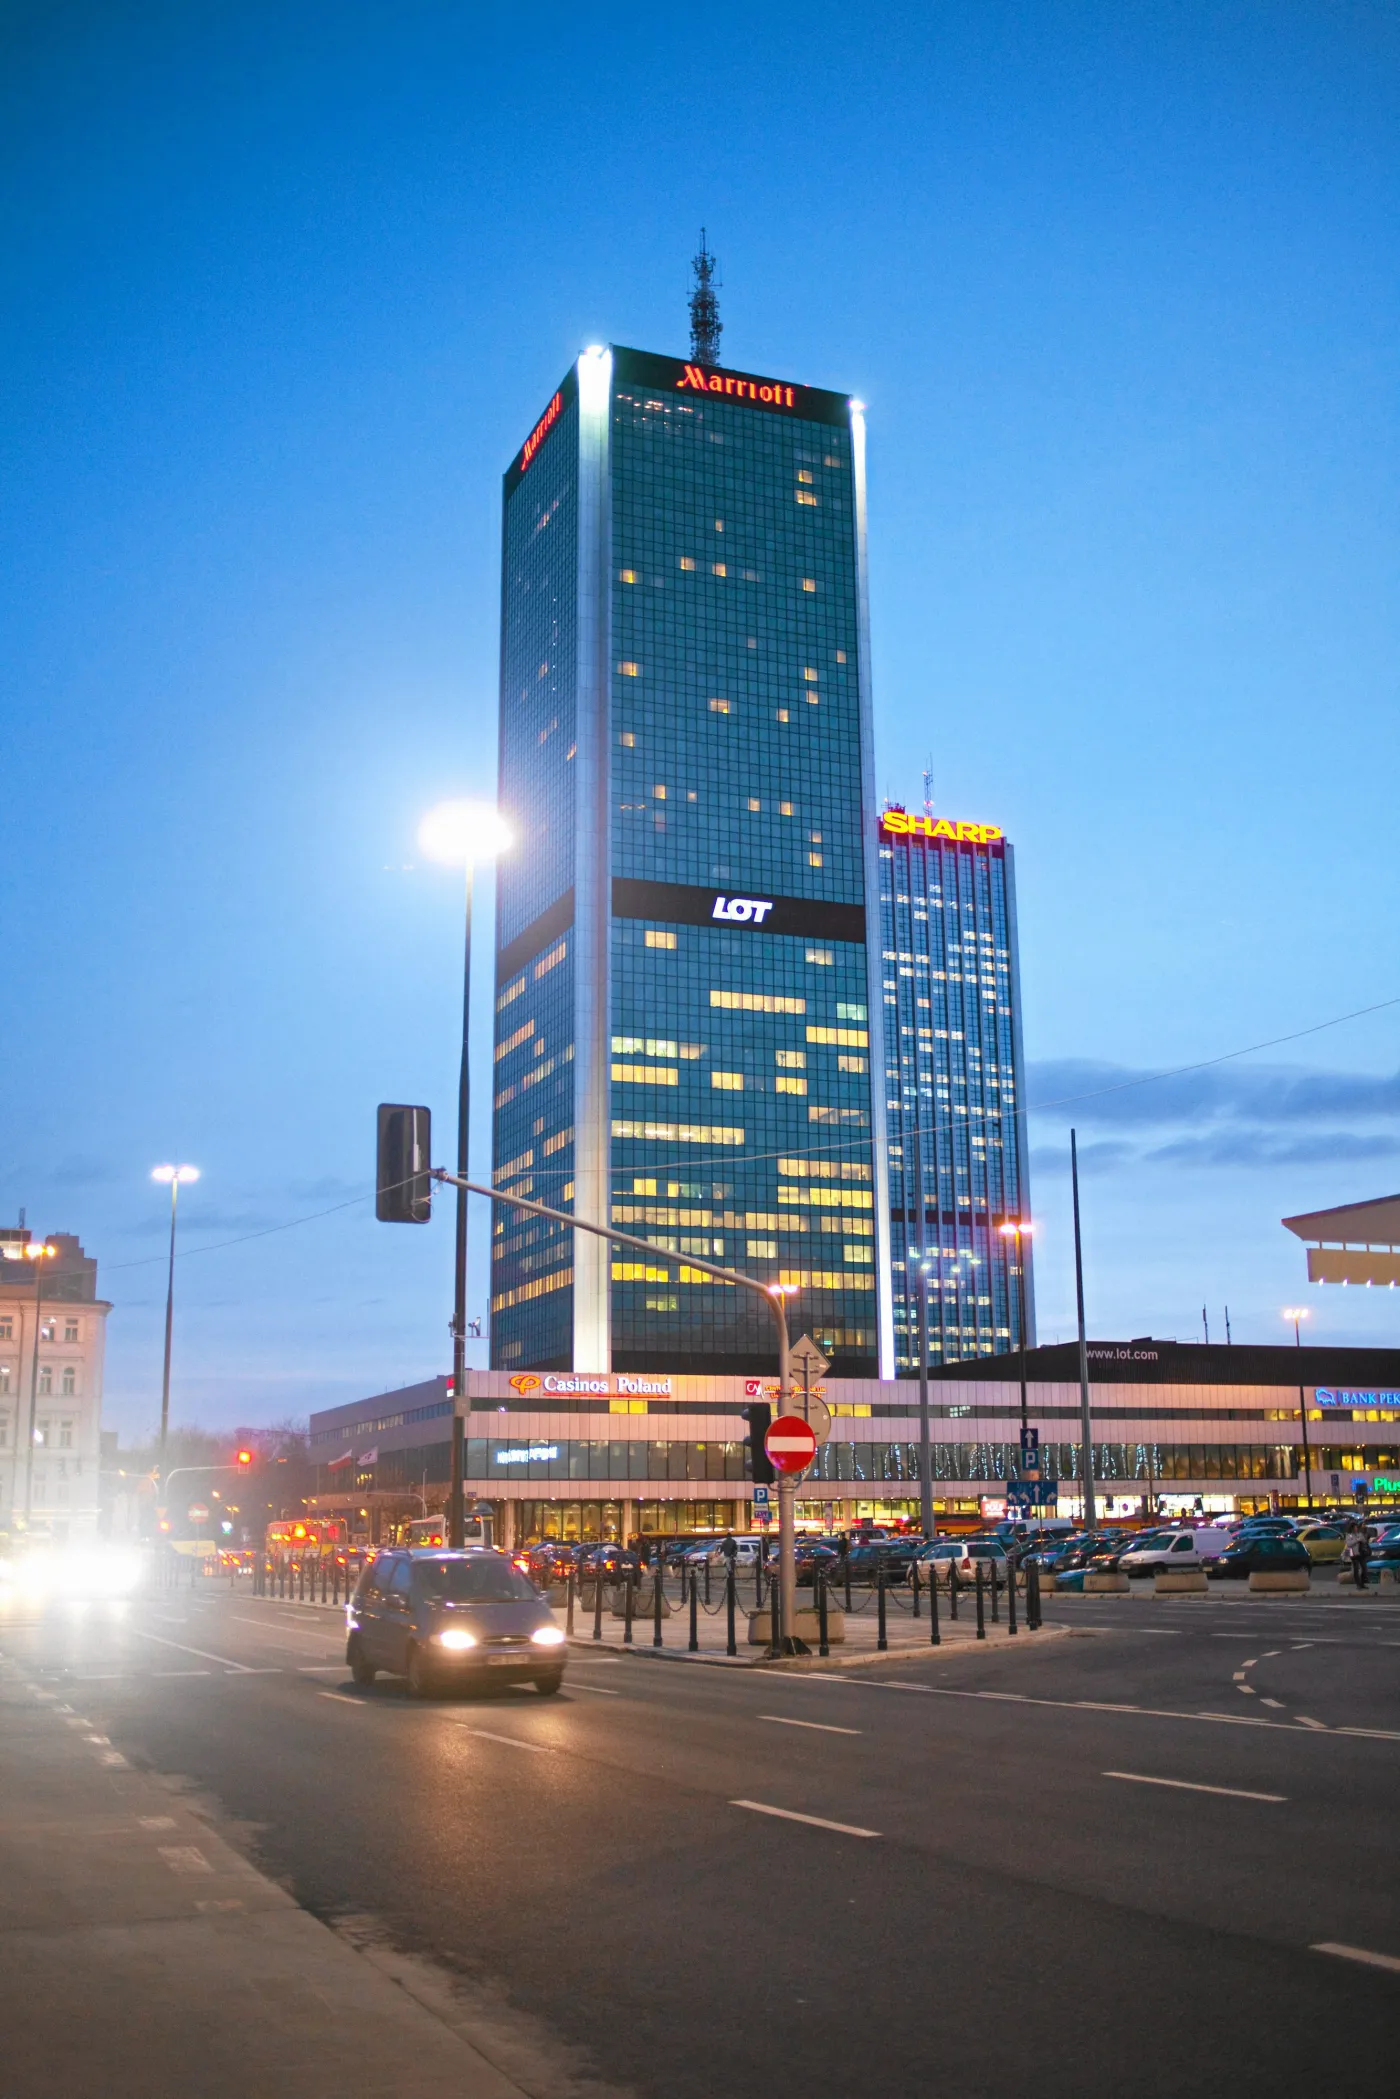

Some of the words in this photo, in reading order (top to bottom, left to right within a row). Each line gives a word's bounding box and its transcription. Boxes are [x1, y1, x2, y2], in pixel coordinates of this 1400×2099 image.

[676, 364, 794, 408] Marriott
[520, 391, 562, 472] Marriott
[883, 811, 1002, 844] SHARP
[712, 896, 773, 923] LOT
[1086, 1348, 1159, 1360] www.lot.com
[543, 1375, 609, 1393] Casinos
[617, 1377, 672, 1394] Poland
[1341, 1392, 1377, 1405] BANK
[1026, 1452, 1036, 1469] P
[757, 1489, 766, 1502] P
